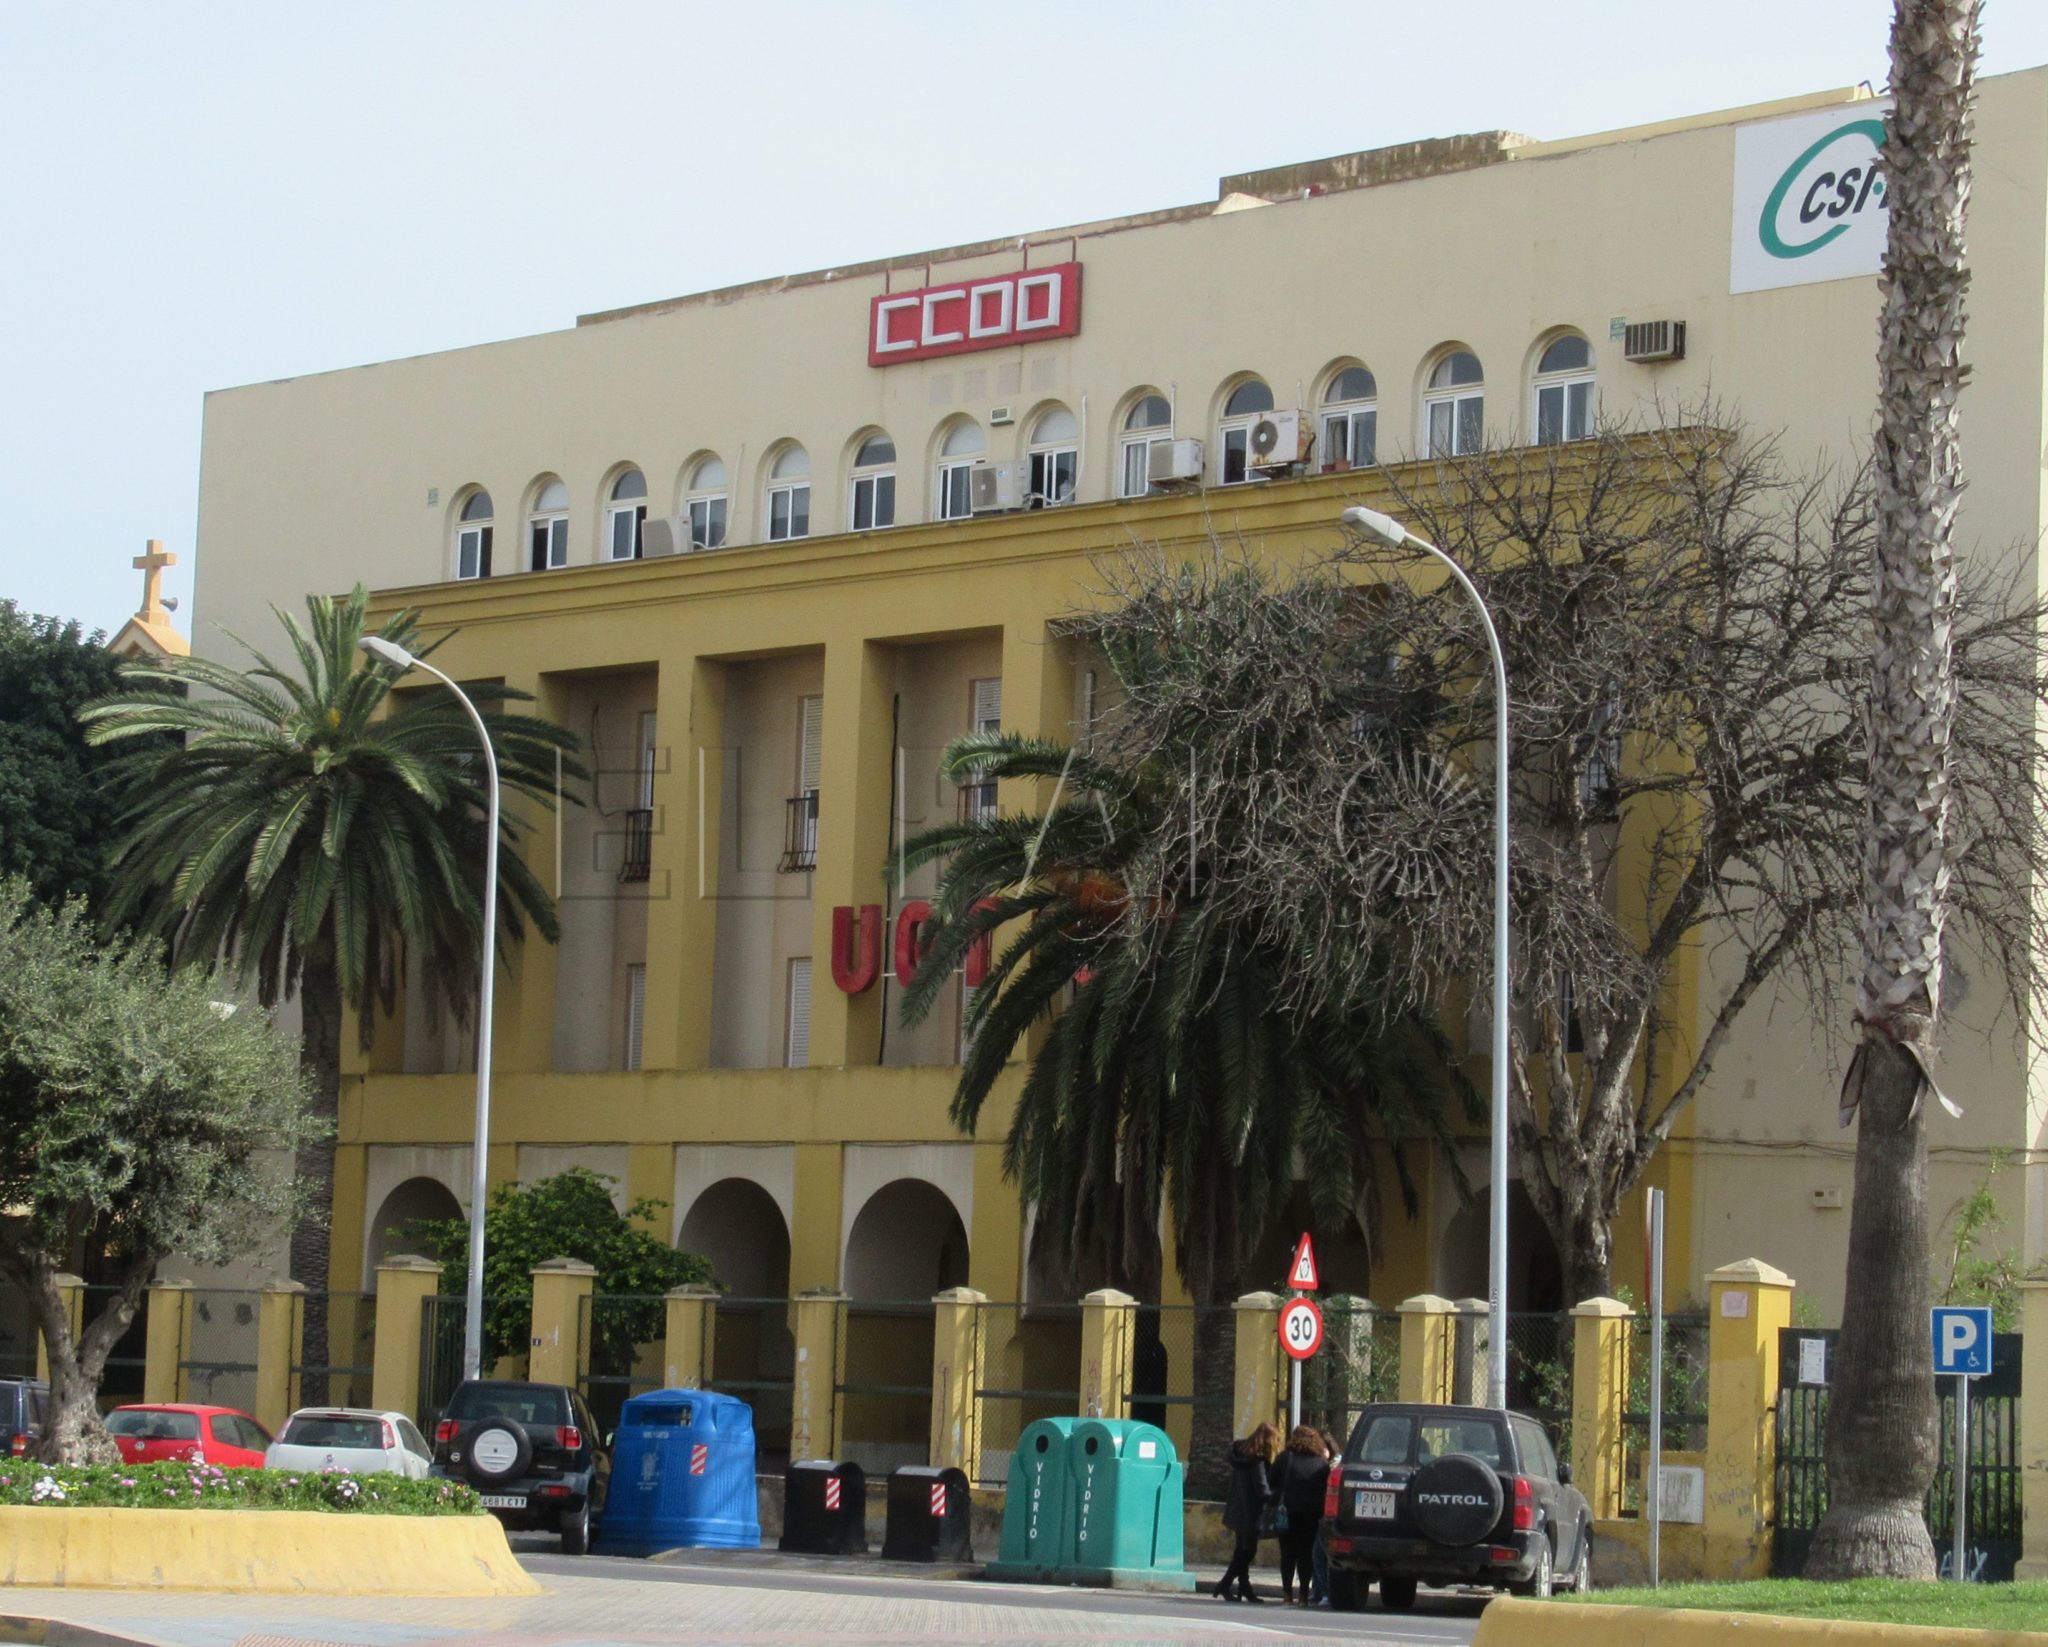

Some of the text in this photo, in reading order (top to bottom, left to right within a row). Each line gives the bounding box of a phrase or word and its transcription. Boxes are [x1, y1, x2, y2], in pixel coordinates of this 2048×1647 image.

[876, 273, 1062, 352] CCOO
[1291, 1315, 1312, 1341] 30
[1942, 1315, 1977, 1366] P
[1029, 1462, 1044, 1539] VIDRIO
[1079, 1464, 1095, 1541] VIDRIO
[1363, 1492, 1392, 1504] 2017
[1418, 1494, 1489, 1506] PATROL
